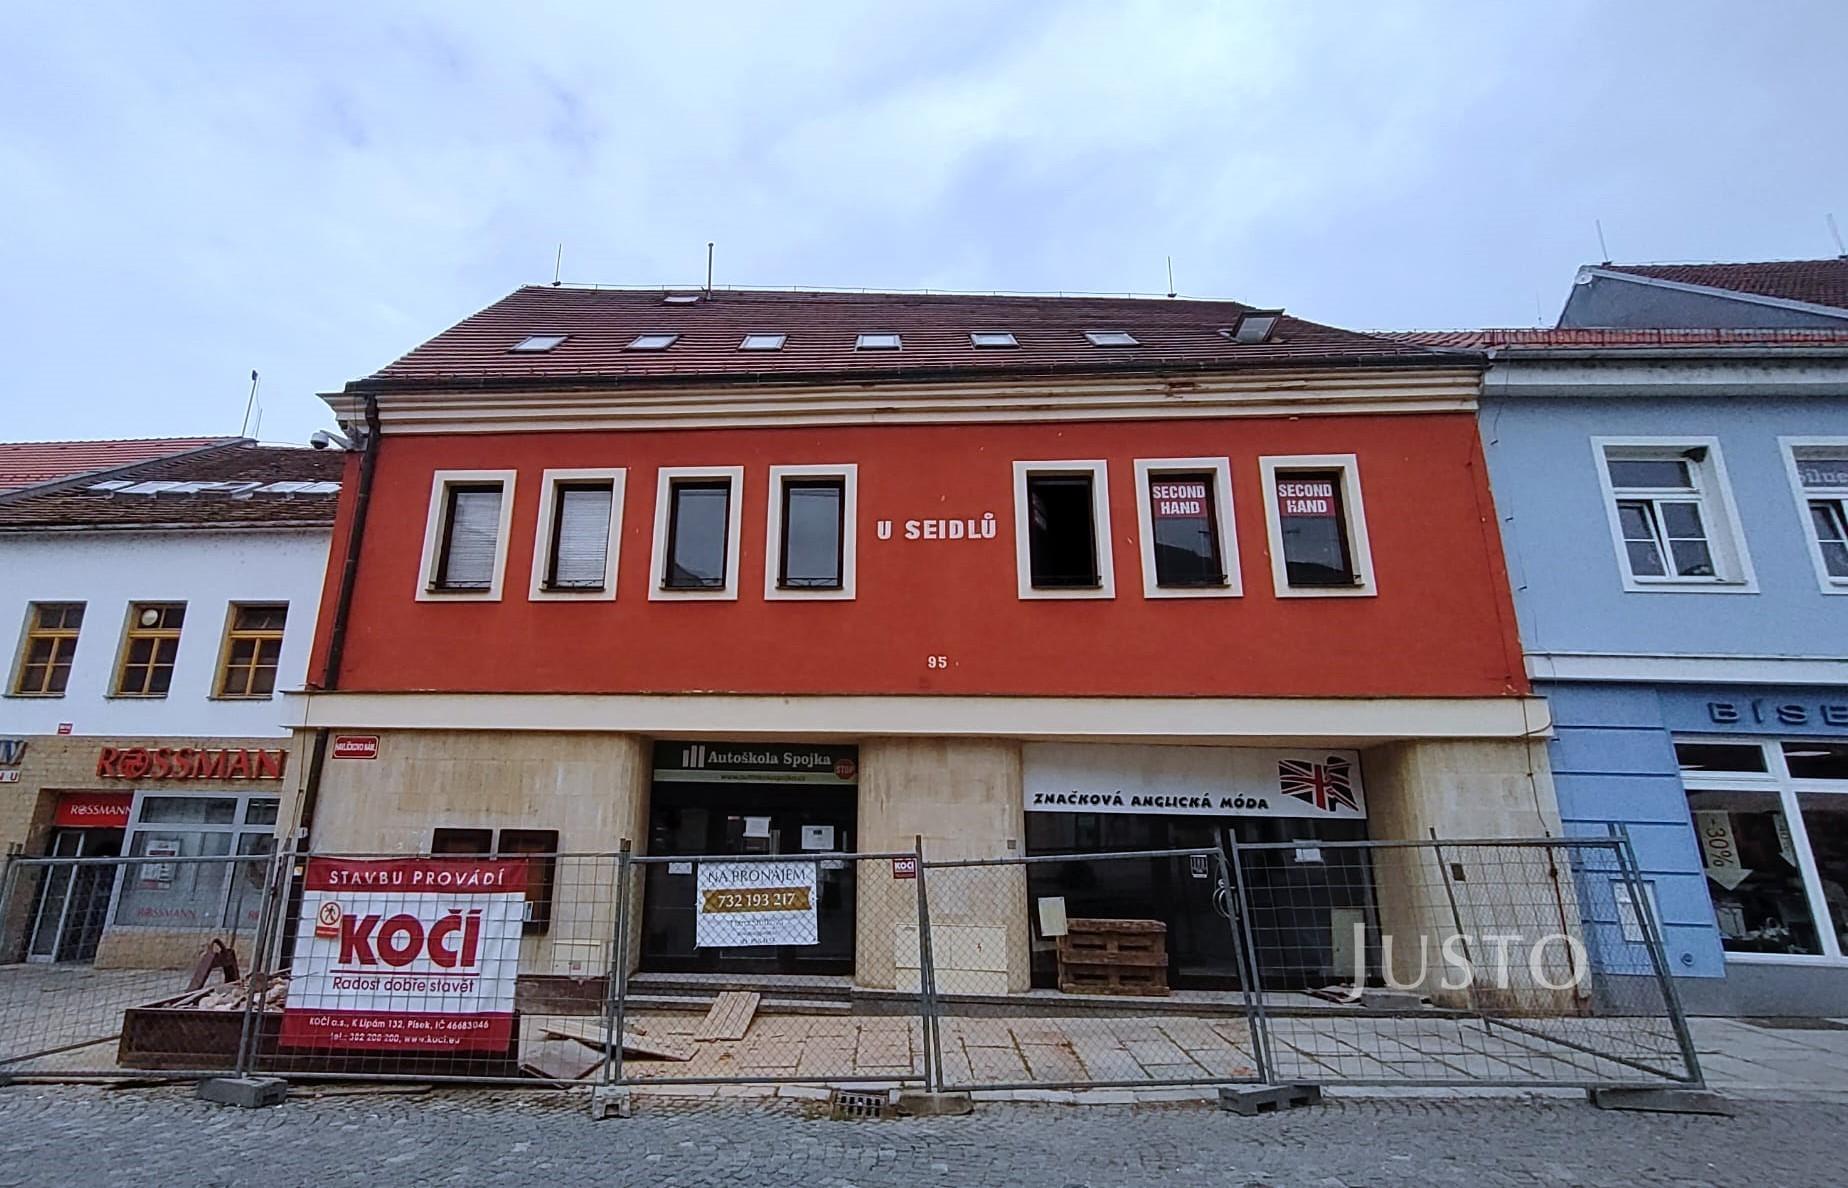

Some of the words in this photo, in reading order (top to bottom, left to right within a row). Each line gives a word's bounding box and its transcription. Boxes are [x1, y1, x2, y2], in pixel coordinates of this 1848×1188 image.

[1152, 485, 1206, 499] SECOND
[1278, 483, 1333, 497] SECOND
[1160, 501, 1201, 515] HAND
[1286, 499, 1328, 513] HAND
[877, 520, 892, 540] U
[904, 512, 996, 540] SEIDLŮ
[927, 656, 948, 669] 95
[707, 751, 779, 764] Autoškola
[783, 752, 832, 768] Spojka
[1033, 790, 1124, 806] ZNAČKOVÁ
[1131, 793, 1212, 808] ANGLICKÁ
[1219, 794, 1269, 809] MÓDA
[1706, 819, 1734, 868] -30%
[329, 870, 403, 885] STAVBU
[413, 868, 505, 886] PROVÁDÍ
[708, 869, 729, 883] NA
[732, 866, 806, 884] PRONÁJEM
[718, 894, 742, 908] 732
[746, 893, 769, 906] 193
[773, 892, 796, 906] 217
[338, 908, 483, 968] KOČÍ
[333, 976, 380, 991] Radost
[384, 977, 426, 992] dobře
[430, 978, 475, 993] stavět
[309, 1015, 331, 1026] KOČÍ
[351, 1018, 358, 1028] K
[435, 1019, 446, 1029] IČ
